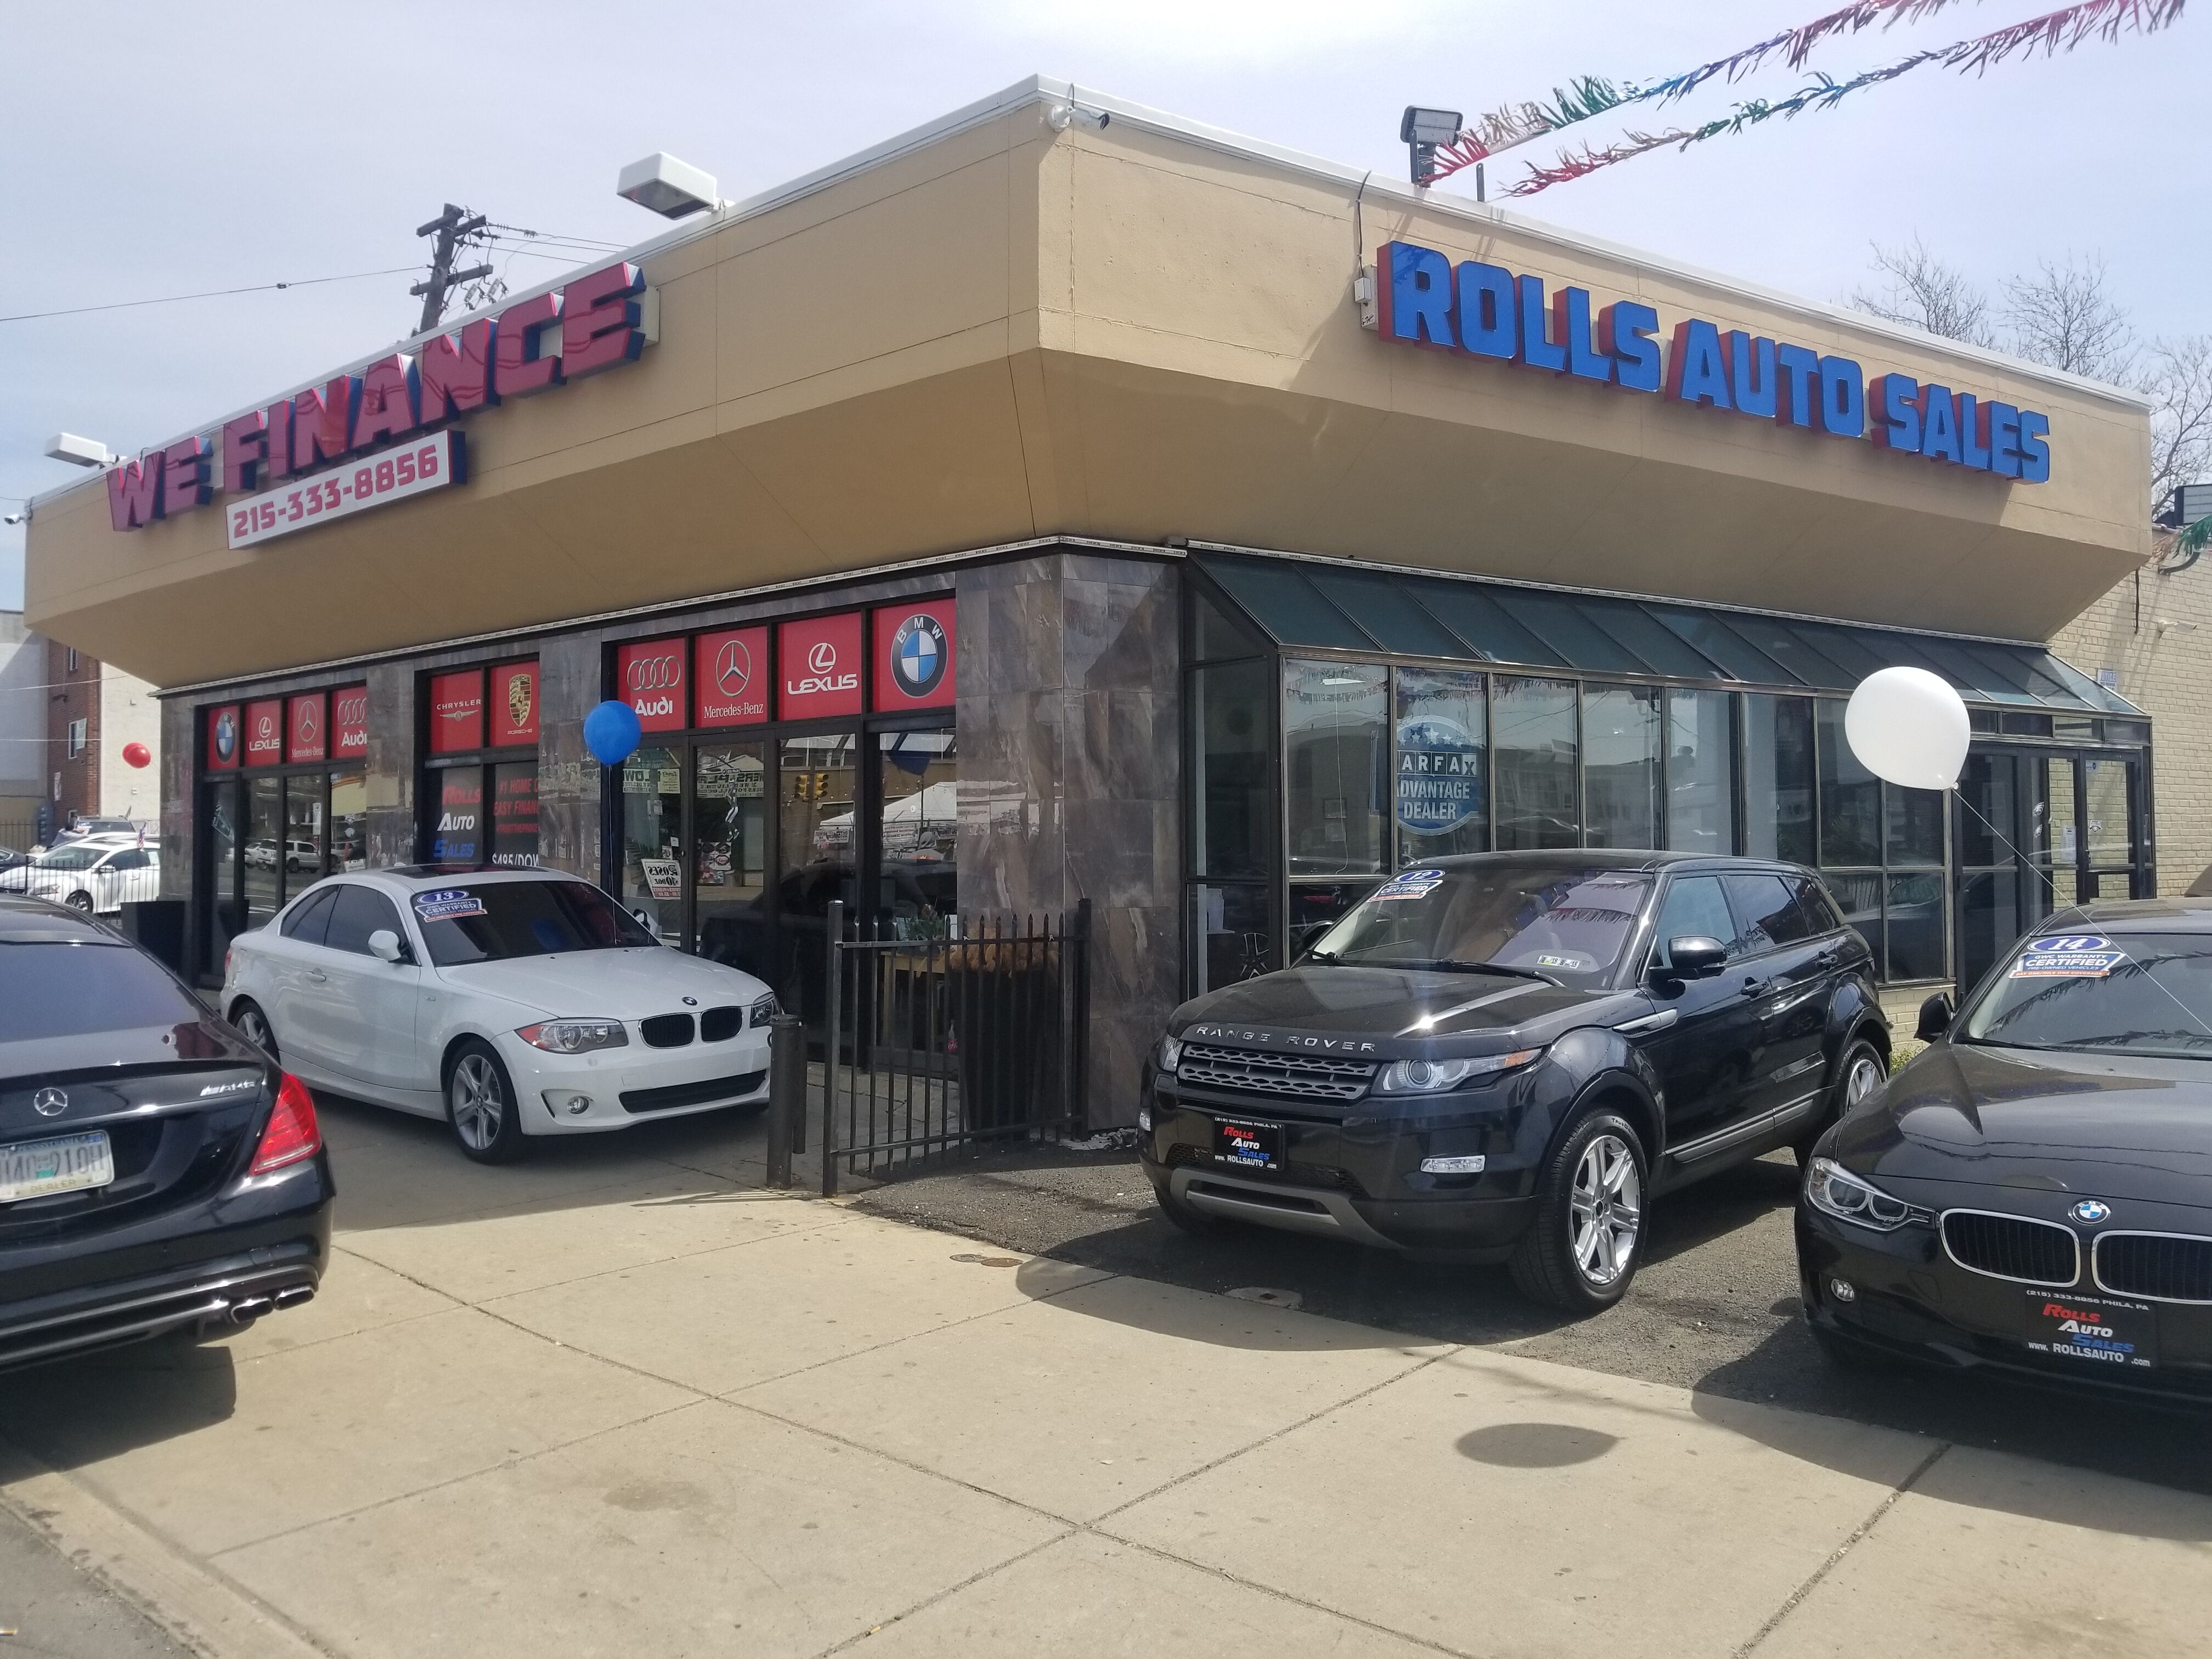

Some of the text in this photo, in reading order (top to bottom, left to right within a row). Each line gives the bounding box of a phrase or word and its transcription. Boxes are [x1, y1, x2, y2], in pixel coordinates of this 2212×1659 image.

[1380, 240, 2050, 484] ROLLS AUTO SALES
[106, 261, 643, 532] WE FINANCE
[233, 444, 438, 539] 215-333-8856
[897, 617, 943, 644] BMW
[787, 673, 857, 695] LEXUS
[437, 699, 481, 710] CHRYSLER
[635, 696, 673, 716] Audi
[704, 702, 764, 719] Mercedes-Benz
[249, 738, 280, 752] LEXUS
[291, 746, 324, 759] Mercedes-Benz
[1401, 754, 1476, 776] ARFAX
[514, 800, 539, 815] FINAN
[1404, 802, 1457, 820] DEALER
[437, 812, 475, 831] AUTO
[433, 839, 475, 857] SALES
[435, 891, 454, 901] 13
[1381, 885, 1429, 894] CERTIFIED
[425, 904, 477, 914] CERTIFIED
[2048, 938, 2089, 950] 14
[1197, 1026, 1376, 1052] RANGE ROVER
[1223, 1126, 1255, 1139] ROLLS
[1231, 1137, 1260, 1149] AUTO
[1227, 1155, 1263, 1167] ROLLSAUTO
[1238, 1147, 1271, 1160] SALES
[2027, 1290, 2051, 1298] (215)
[2053, 1293, 2100, 1304] 333-8856
[2042, 1302, 2101, 1323] ROLLS
[2058, 1319, 2113, 1338] AUTO
[2072, 1334, 2134, 1353] SALES
[2053, 1342, 2124, 1363] ROLLSAUTO
[2131, 1358, 2151, 1367] .com
